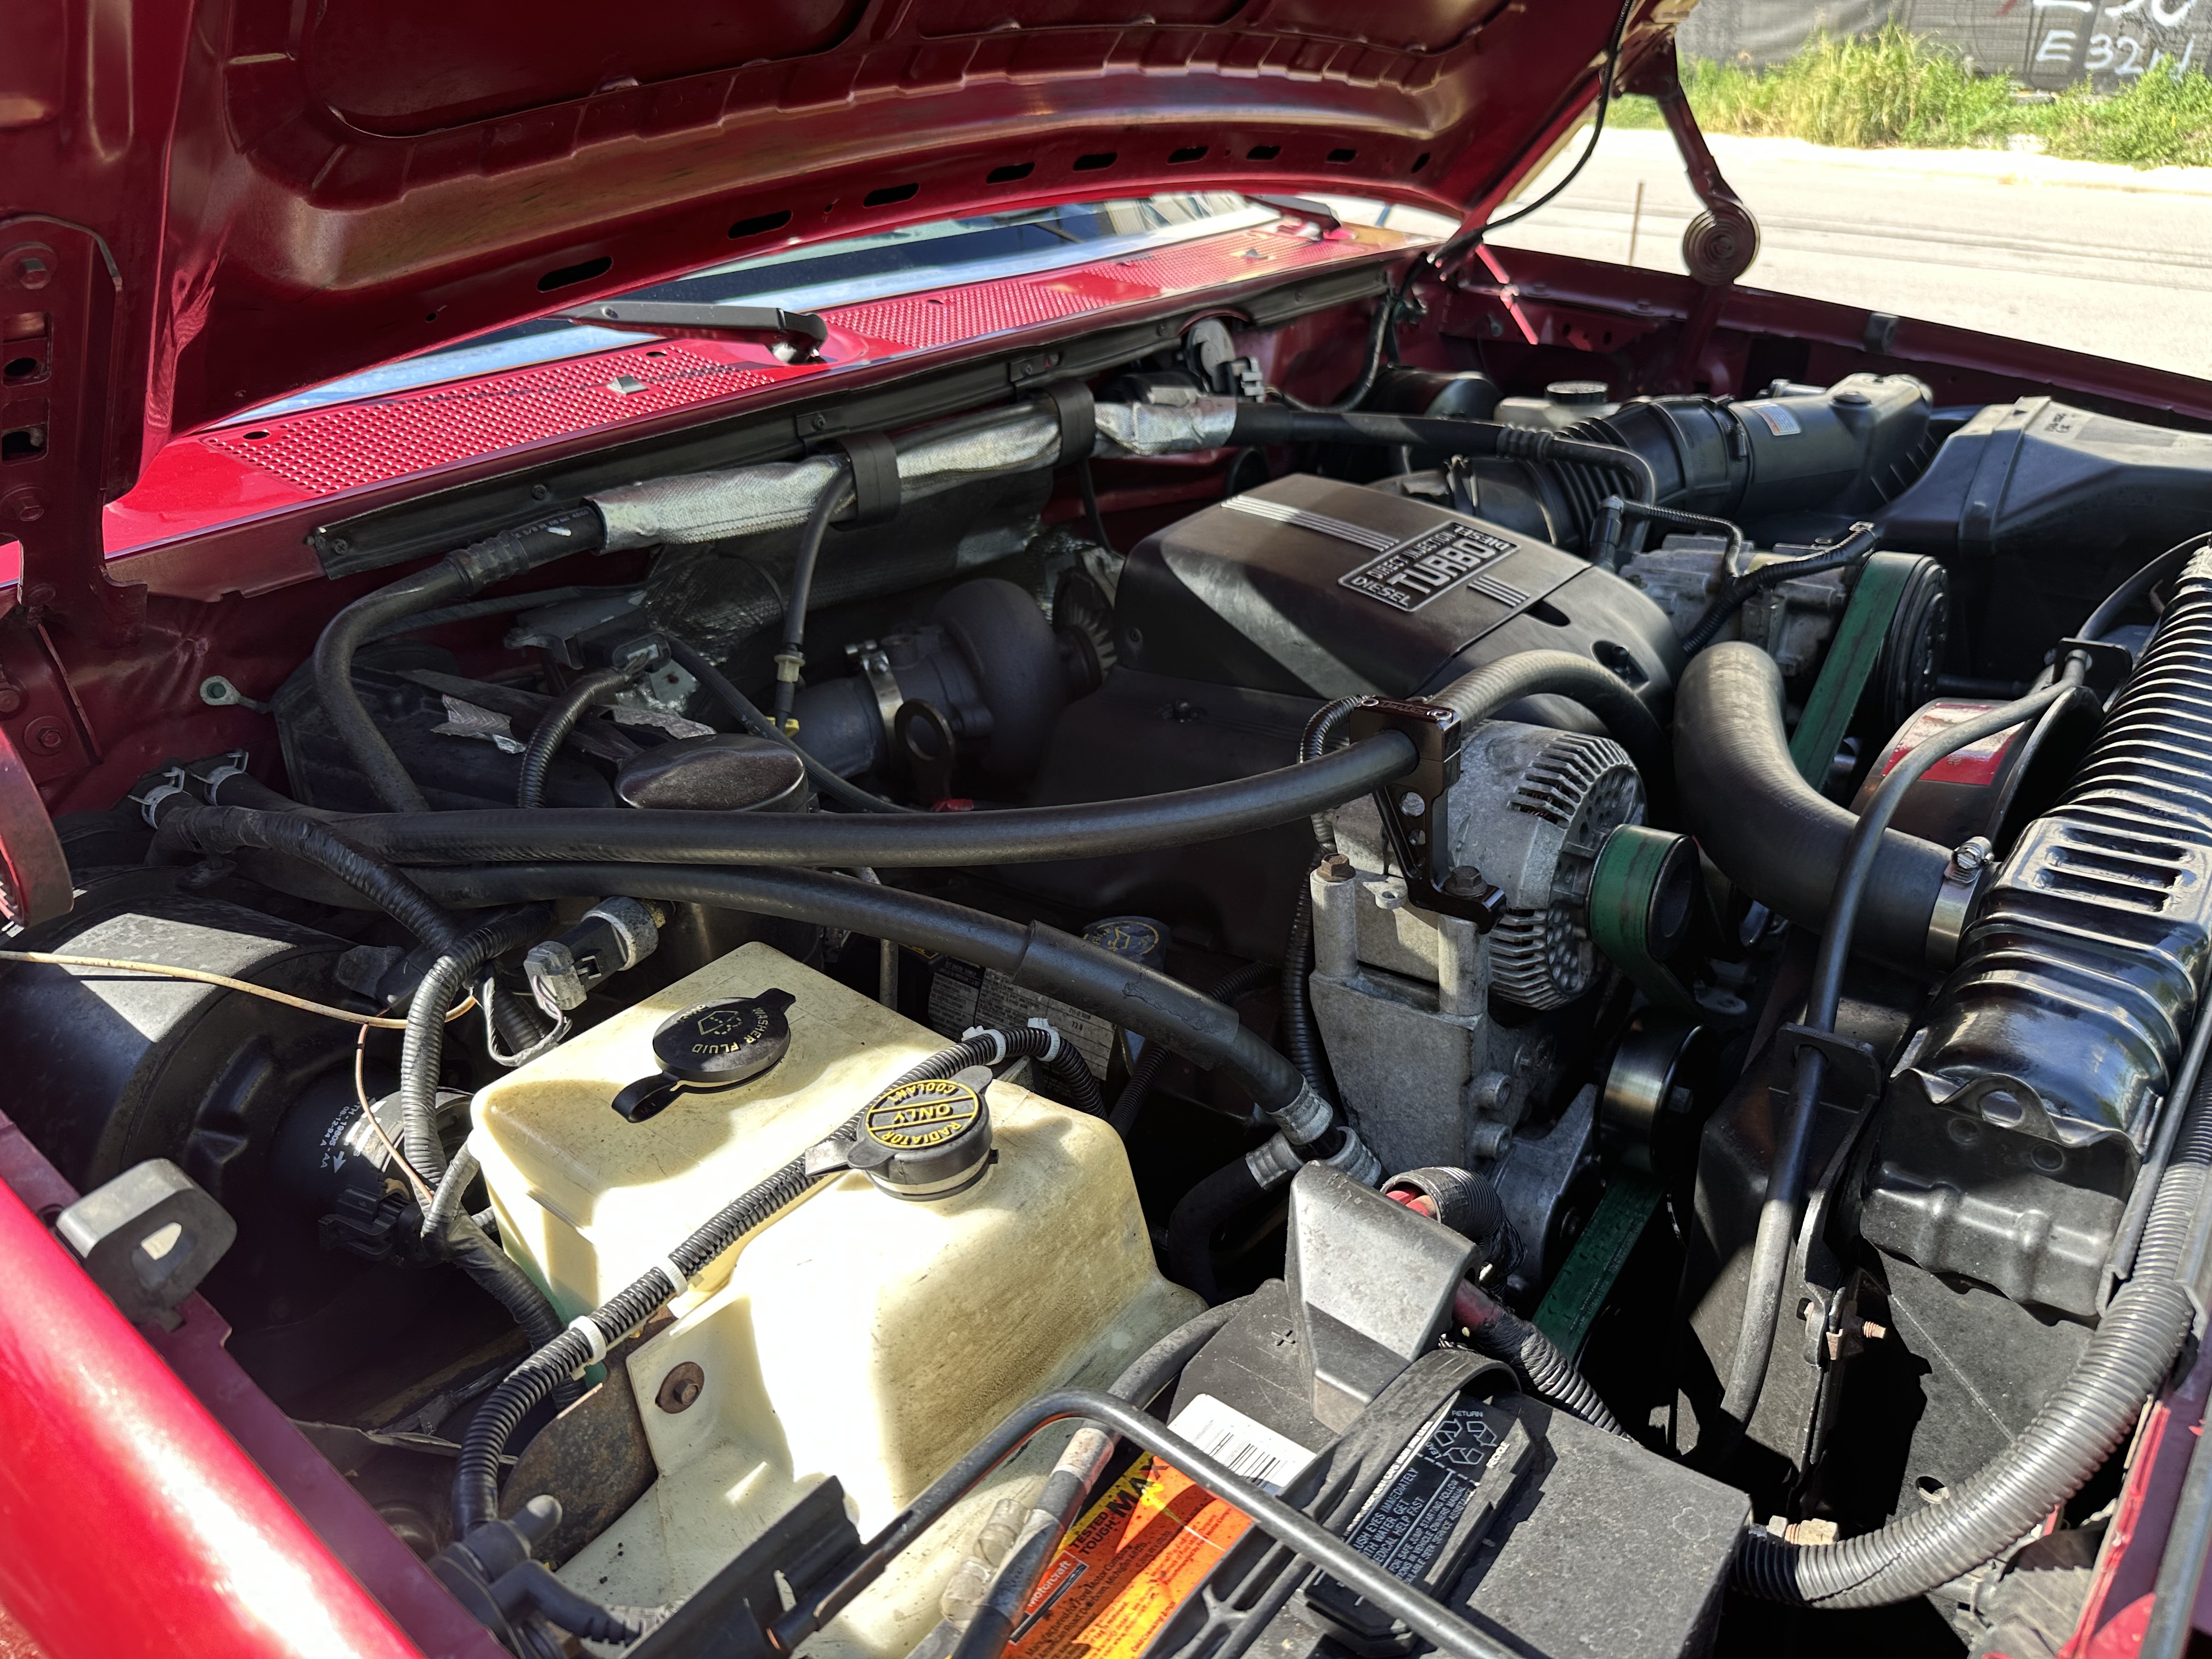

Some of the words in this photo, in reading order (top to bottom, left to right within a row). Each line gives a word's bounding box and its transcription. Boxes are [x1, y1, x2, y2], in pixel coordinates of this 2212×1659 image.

[1367, 555, 1408, 579] DIRECT
[1406, 532, 1455, 560] INJECTION
[1453, 526, 1511, 550] DIESEL
[1387, 538, 1496, 594] TURBO
[1350, 576, 1412, 607] DIESEL
[743, 1007, 768, 1044] WASHER
[692, 1042, 741, 1054] FLUID
[887, 1082, 957, 1103] COOLANT
[893, 1104, 951, 1122] ONLY
[881, 1122, 962, 1145] RADIATOR
[1425, 1442, 1442, 1459] LEAD
[1486, 1441, 1510, 1468] RECYCLE
[1107, 1457, 1169, 1516] MAX
[1353, 1532, 1370, 1551] LUSH
[1367, 1512, 1384, 1532] EYES
[1381, 1466, 1417, 1513] IMMEDIATELY
[1070, 1510, 1108, 1550] TESTED
[1363, 1542, 1377, 1557] ITH
[1393, 1499, 1408, 1515] GET
[1373, 1535, 1397, 1564] EDICAL
[1393, 1515, 1411, 1536] HELP
[1407, 1497, 1424, 1516] FAST
[1389, 1559, 1401, 1572] FOR
[1398, 1543, 1412, 1560] SAFE
[1409, 1527, 1423, 1544] JUMP
[1420, 1500, 1443, 1528] STARTING
[1413, 1531, 1433, 1555] VEHICLE
[1421, 1543, 1436, 1560] SEEK
[1432, 1521, 1452, 1544] SERVICE
[1074, 1587, 1091, 1604] Ford
[1089, 1569, 1107, 1588] Motor
[1104, 1542, 1132, 1572] Company
[1106, 1559, 1132, 1587] Michigan
